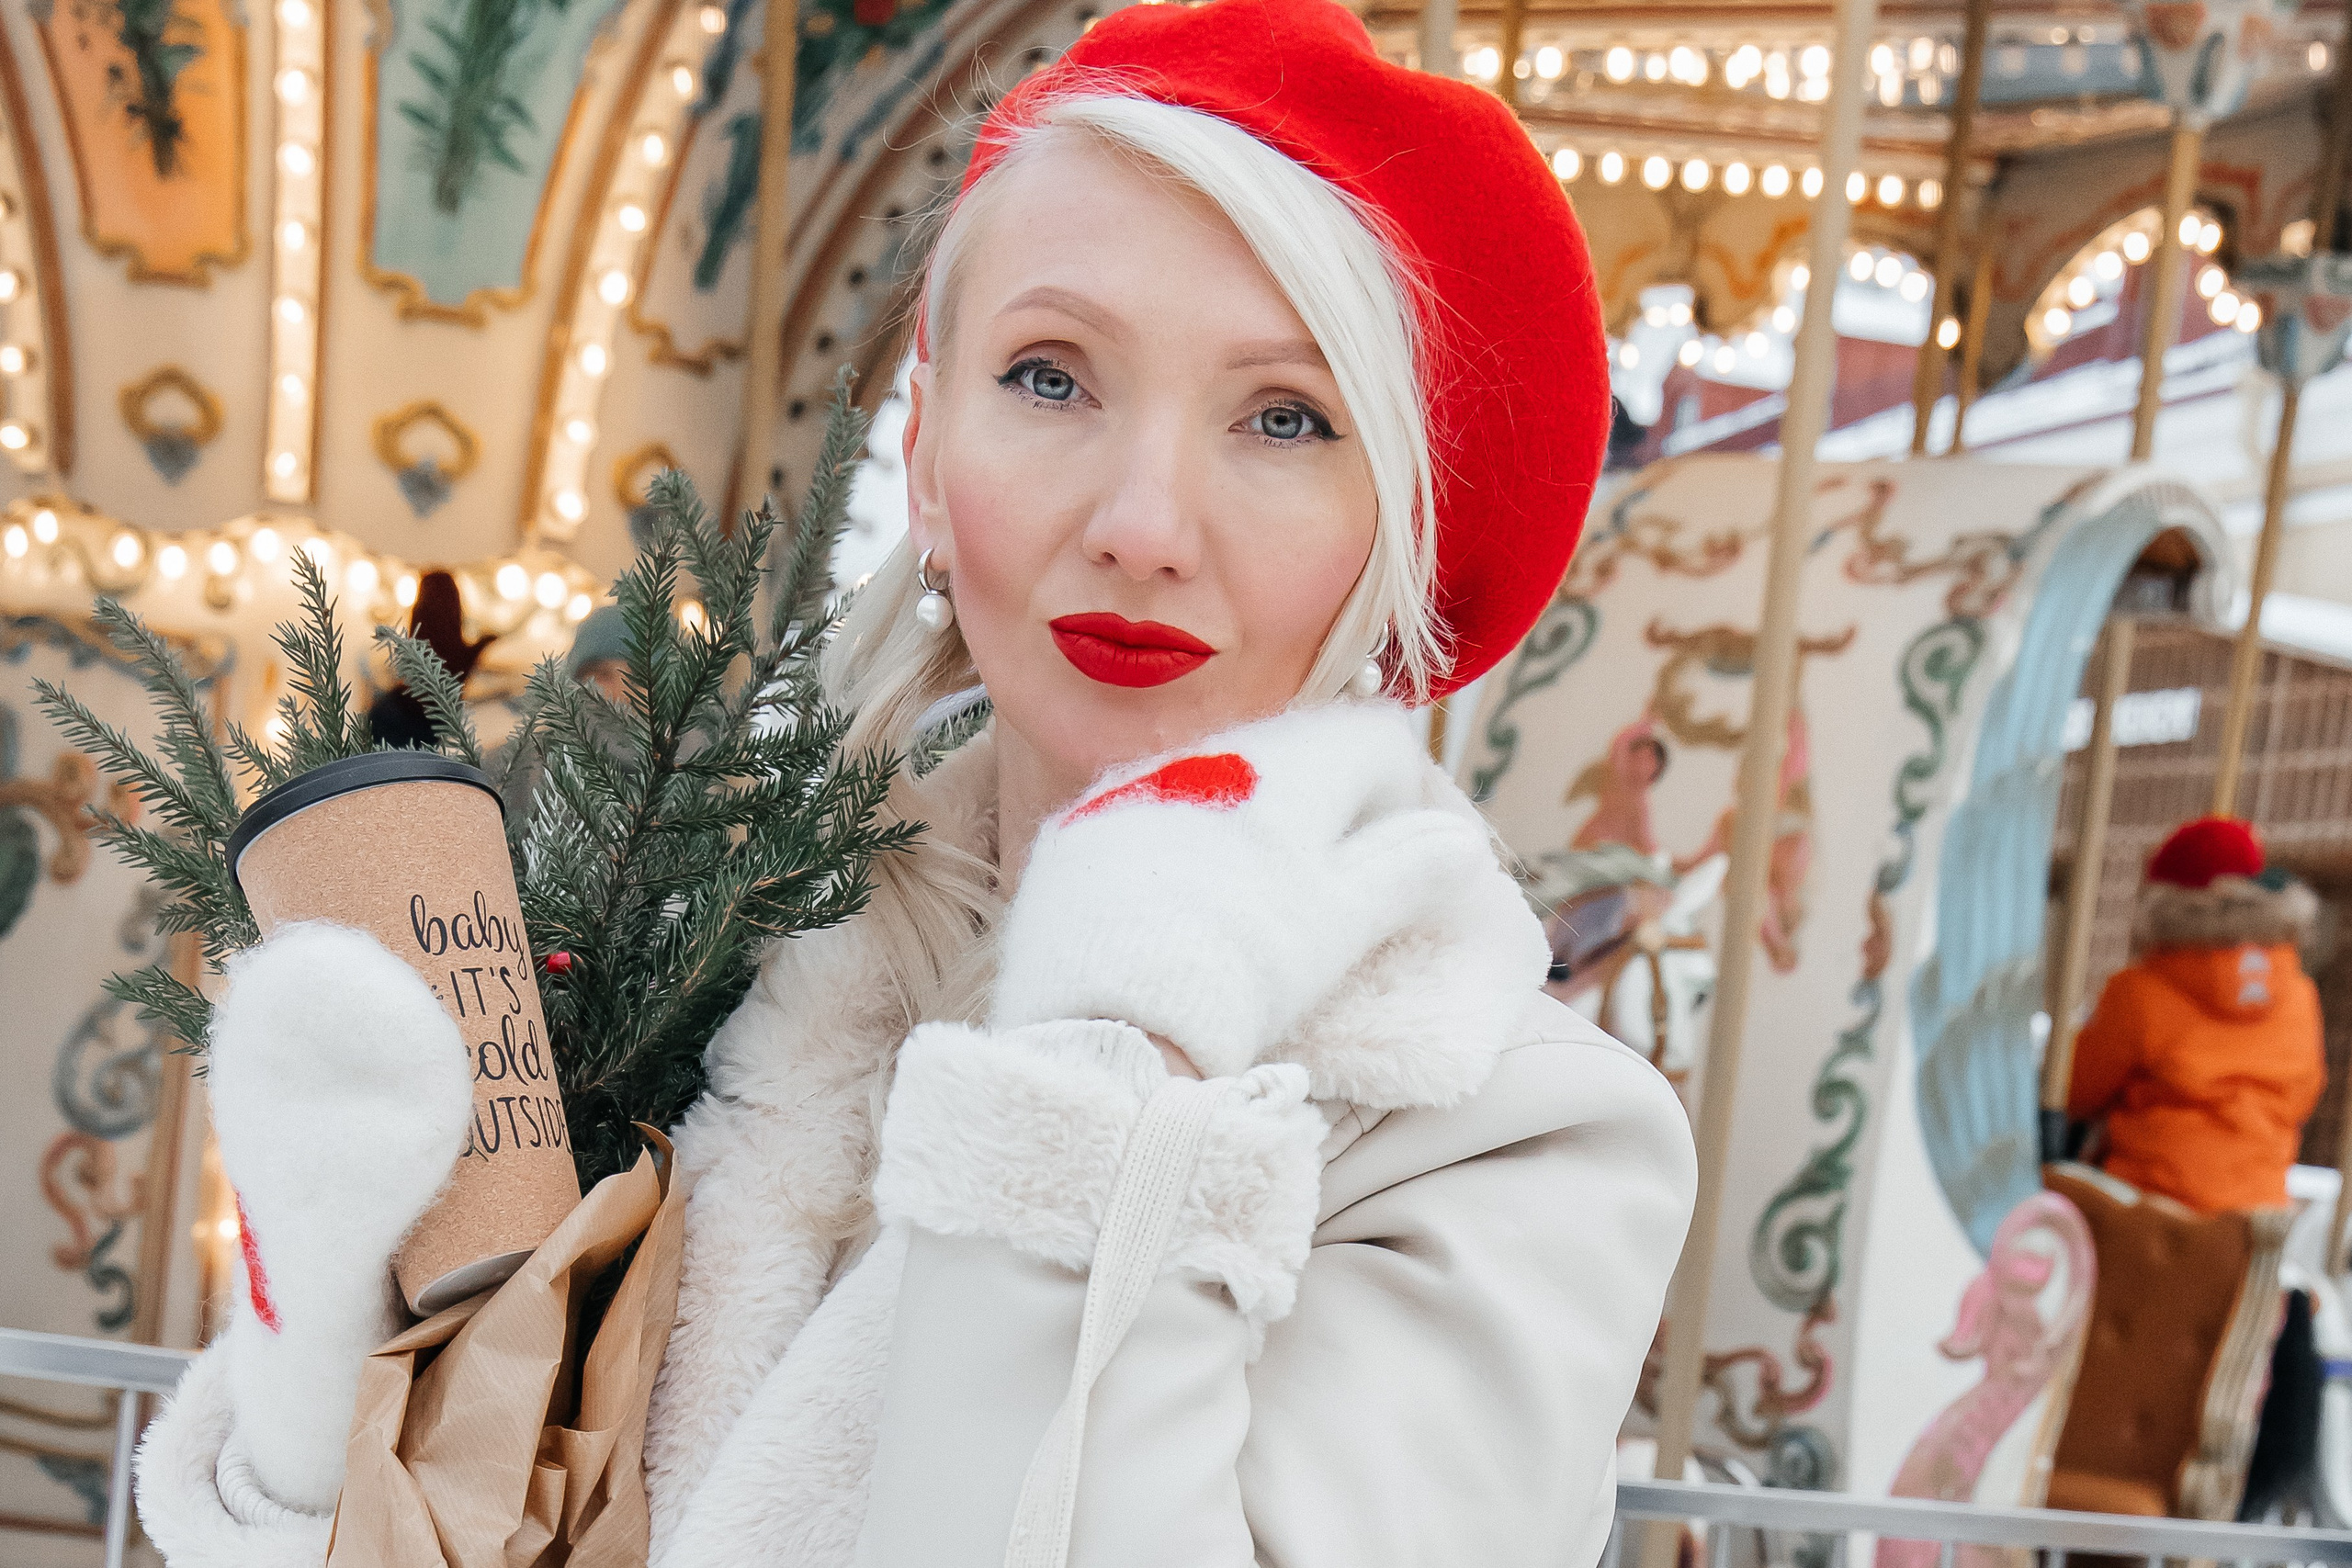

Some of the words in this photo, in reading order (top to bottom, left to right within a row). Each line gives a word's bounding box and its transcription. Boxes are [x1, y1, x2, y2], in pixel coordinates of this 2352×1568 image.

[410, 890, 528, 981] baby
[450, 965, 522, 1018] IT'S
[466, 1014, 548, 1086] old
